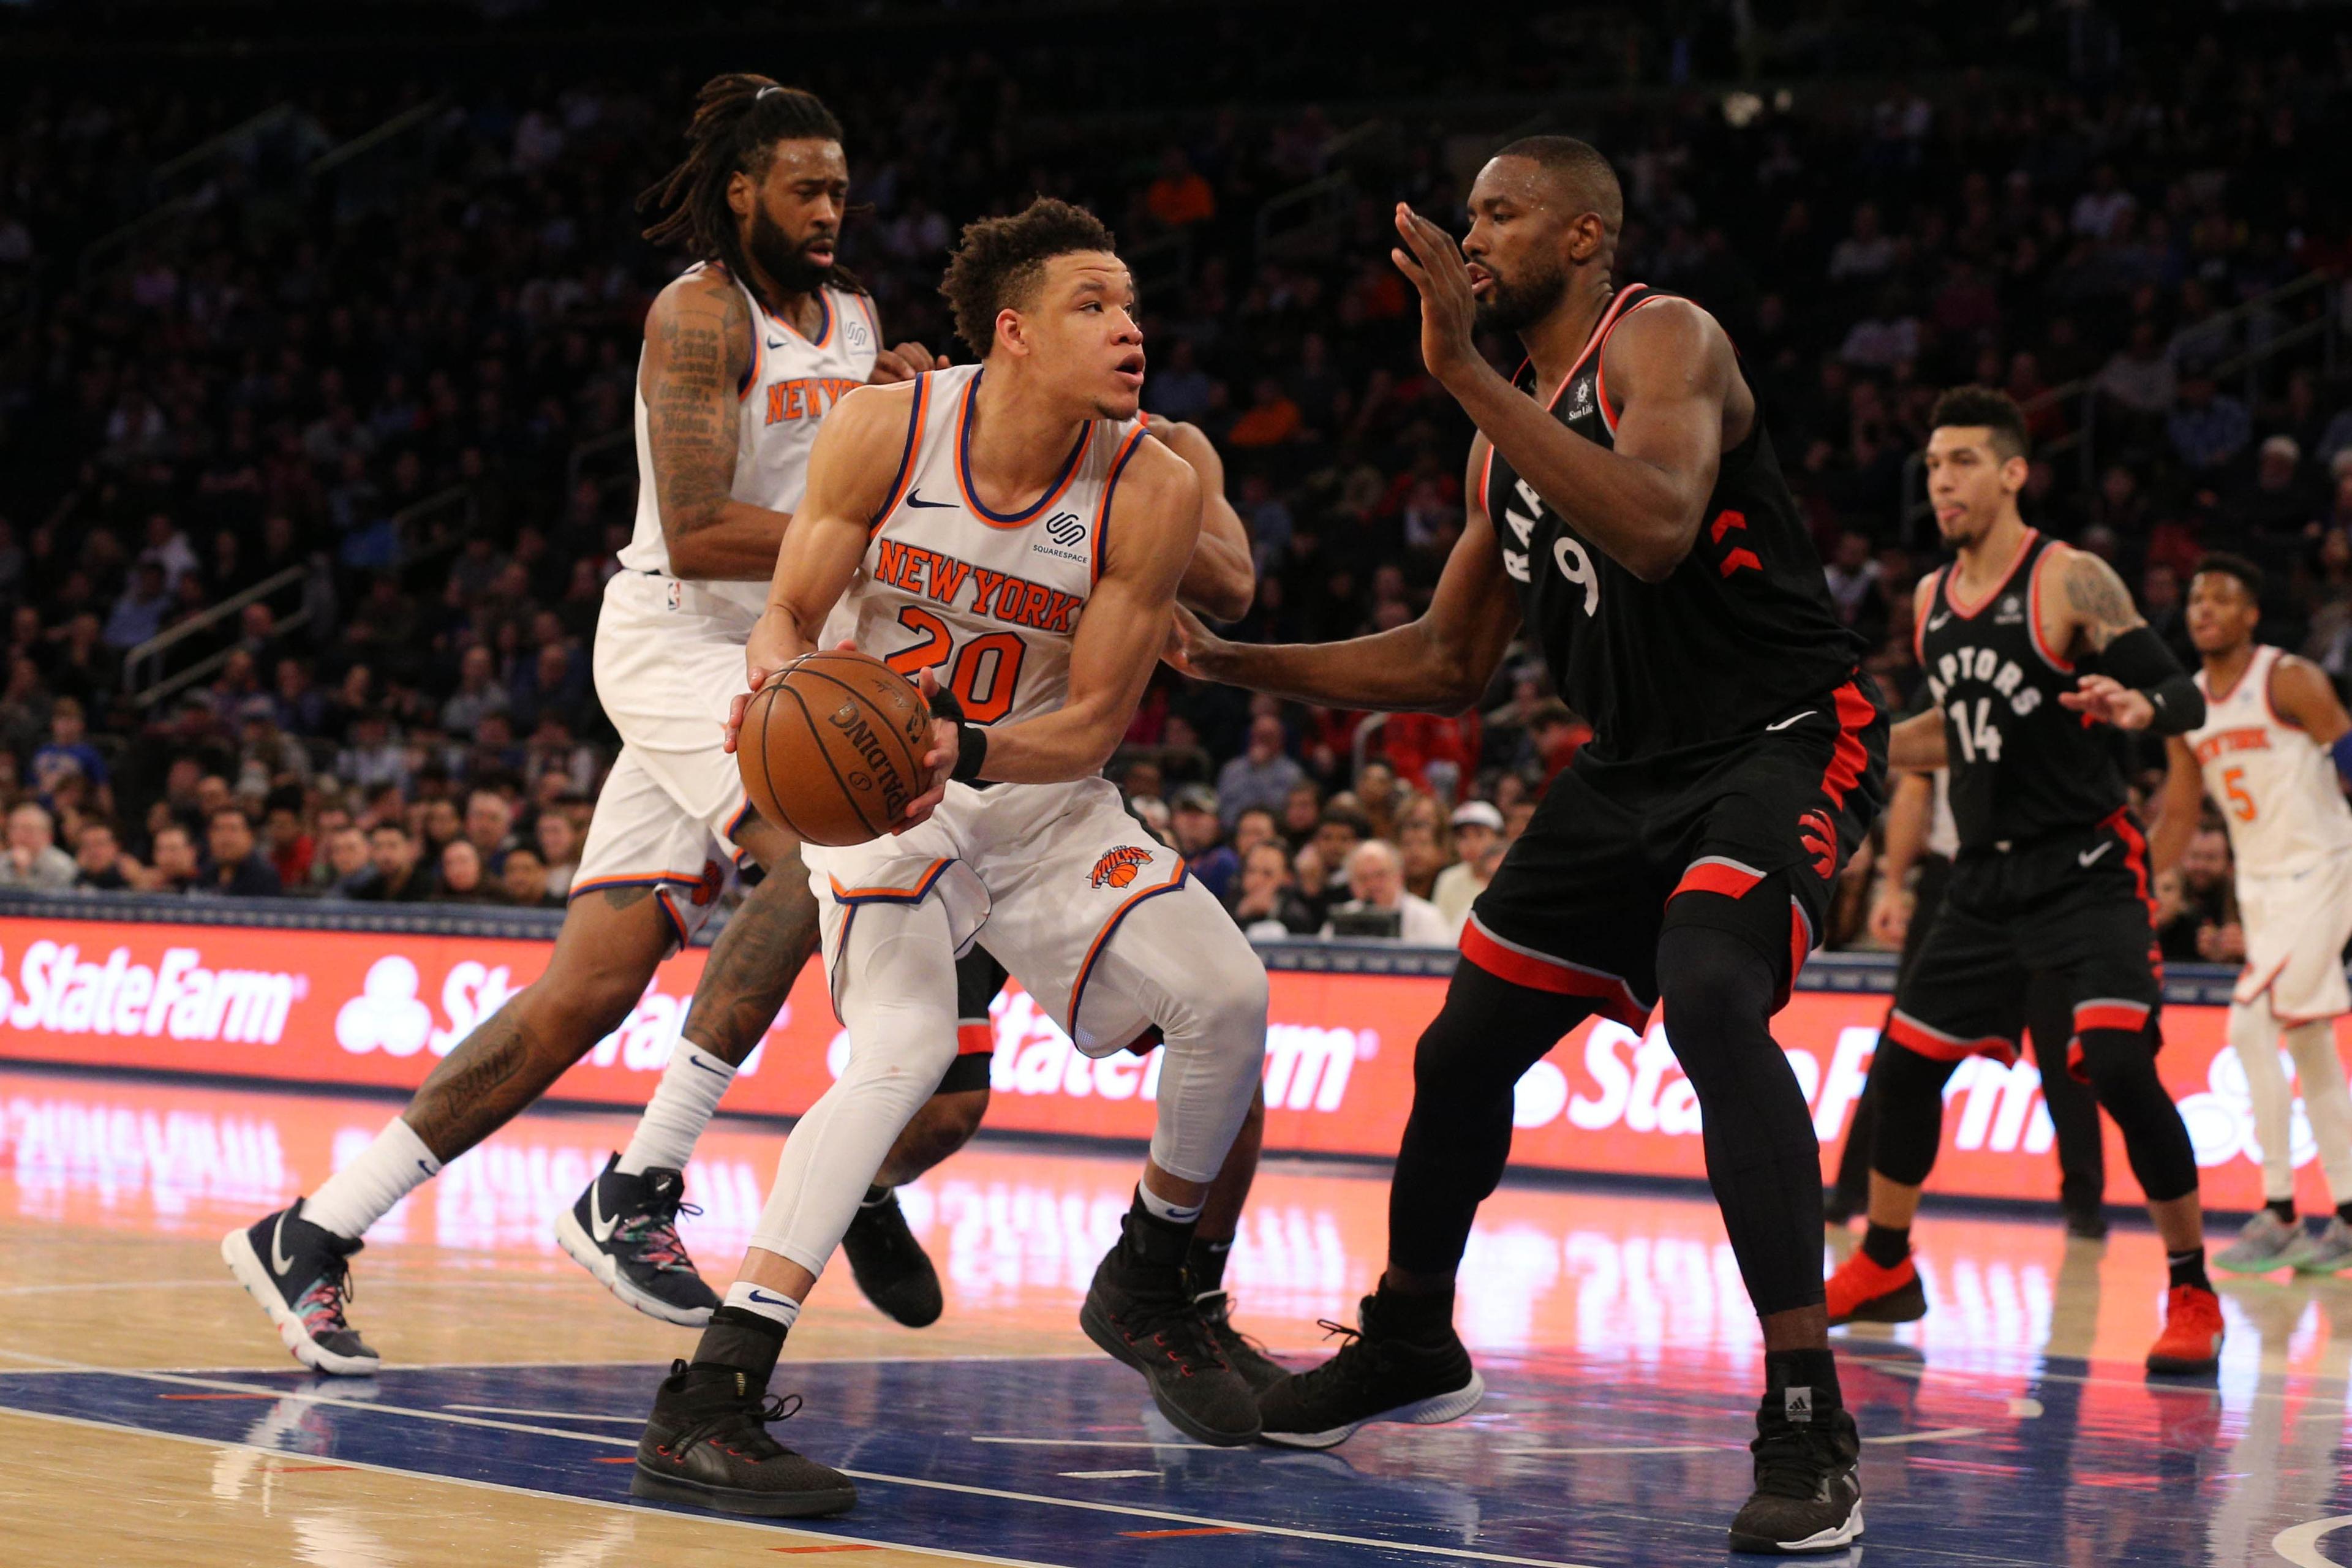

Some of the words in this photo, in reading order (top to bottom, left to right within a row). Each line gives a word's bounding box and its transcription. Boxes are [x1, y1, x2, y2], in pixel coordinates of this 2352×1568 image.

[765, 377, 822, 425] NEW
[873, 537, 971, 606] NEW
[970, 565, 1085, 633] YORK
[1033, 545, 1088, 564] SQUARESPACE
[1553, 537, 1599, 617] 9
[884, 605, 1027, 726] 20
[1928, 646, 2042, 716] APTORS
[1949, 697, 2003, 763] 14
[2224, 767, 2257, 823] 5
[1091, 846, 1153, 889] KNICKS
